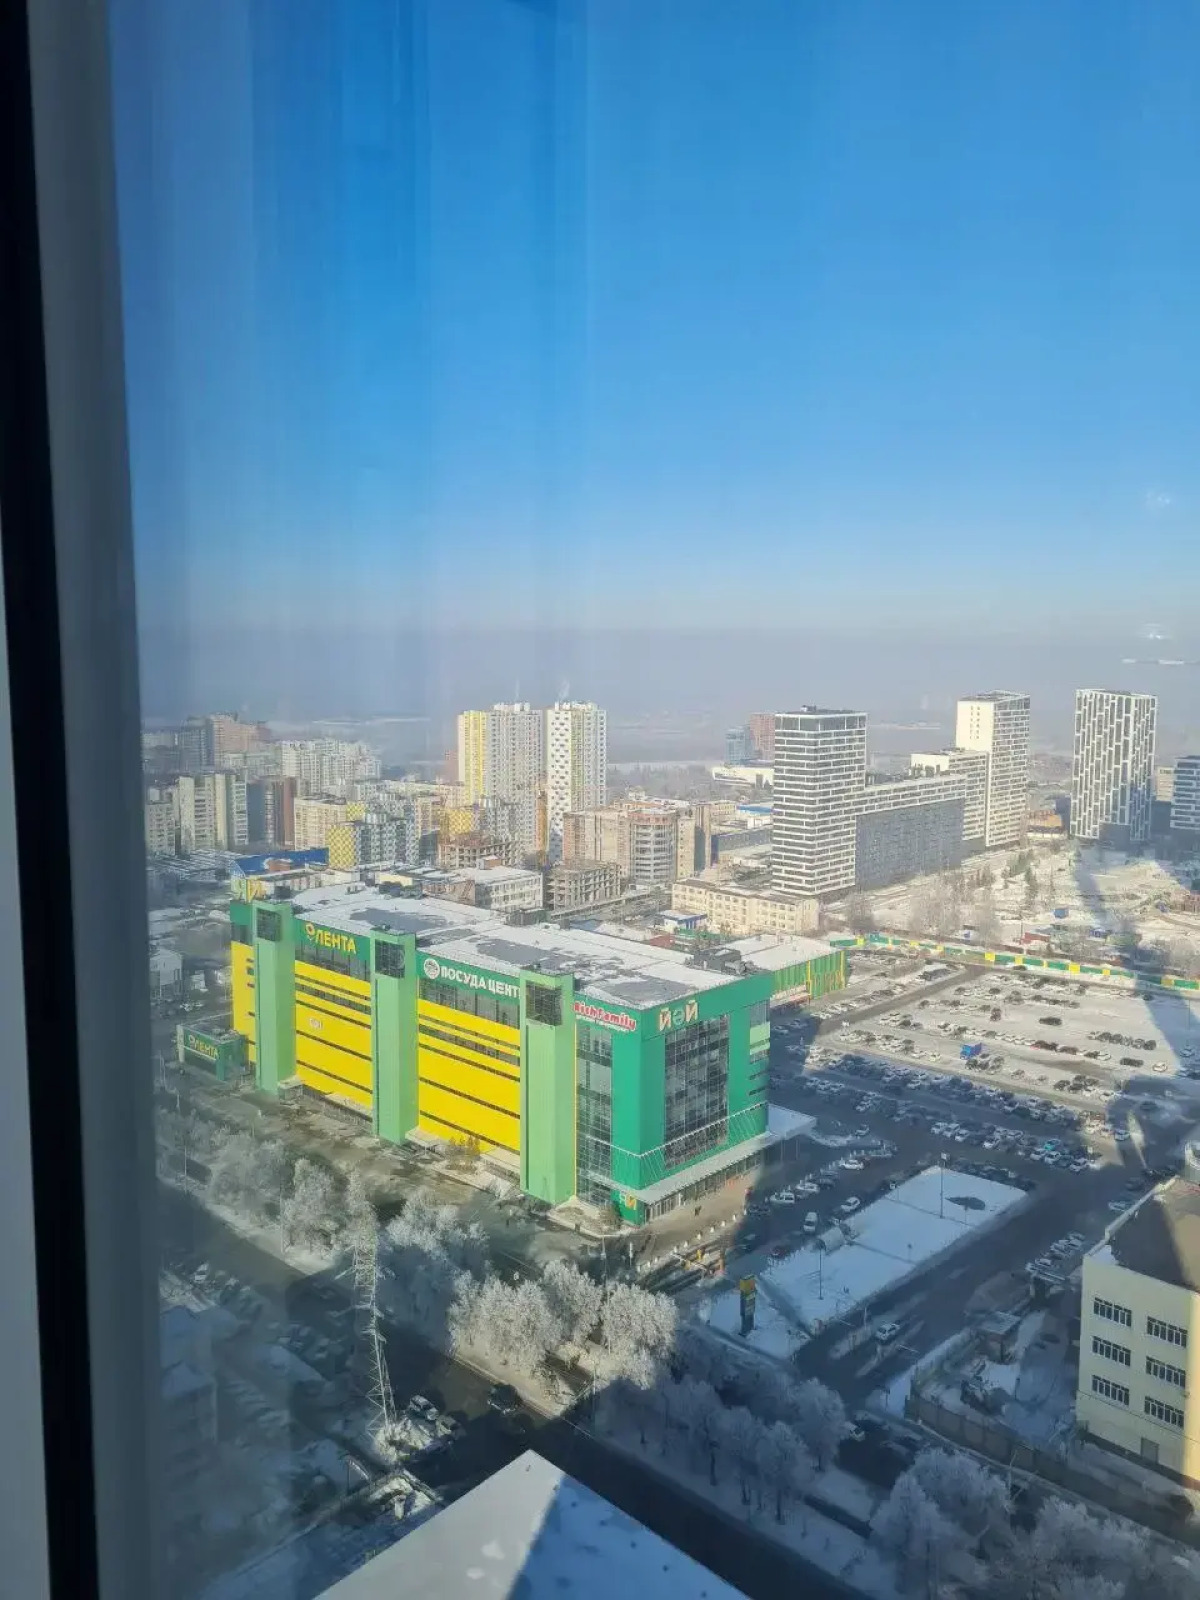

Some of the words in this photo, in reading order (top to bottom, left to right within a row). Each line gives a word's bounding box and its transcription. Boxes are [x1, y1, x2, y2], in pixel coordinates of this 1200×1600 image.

[315, 929, 357, 954] ЛЕНТА
[440, 966, 486, 990] ПОСУДА
[488, 979, 521, 999] ЦЕНТ
